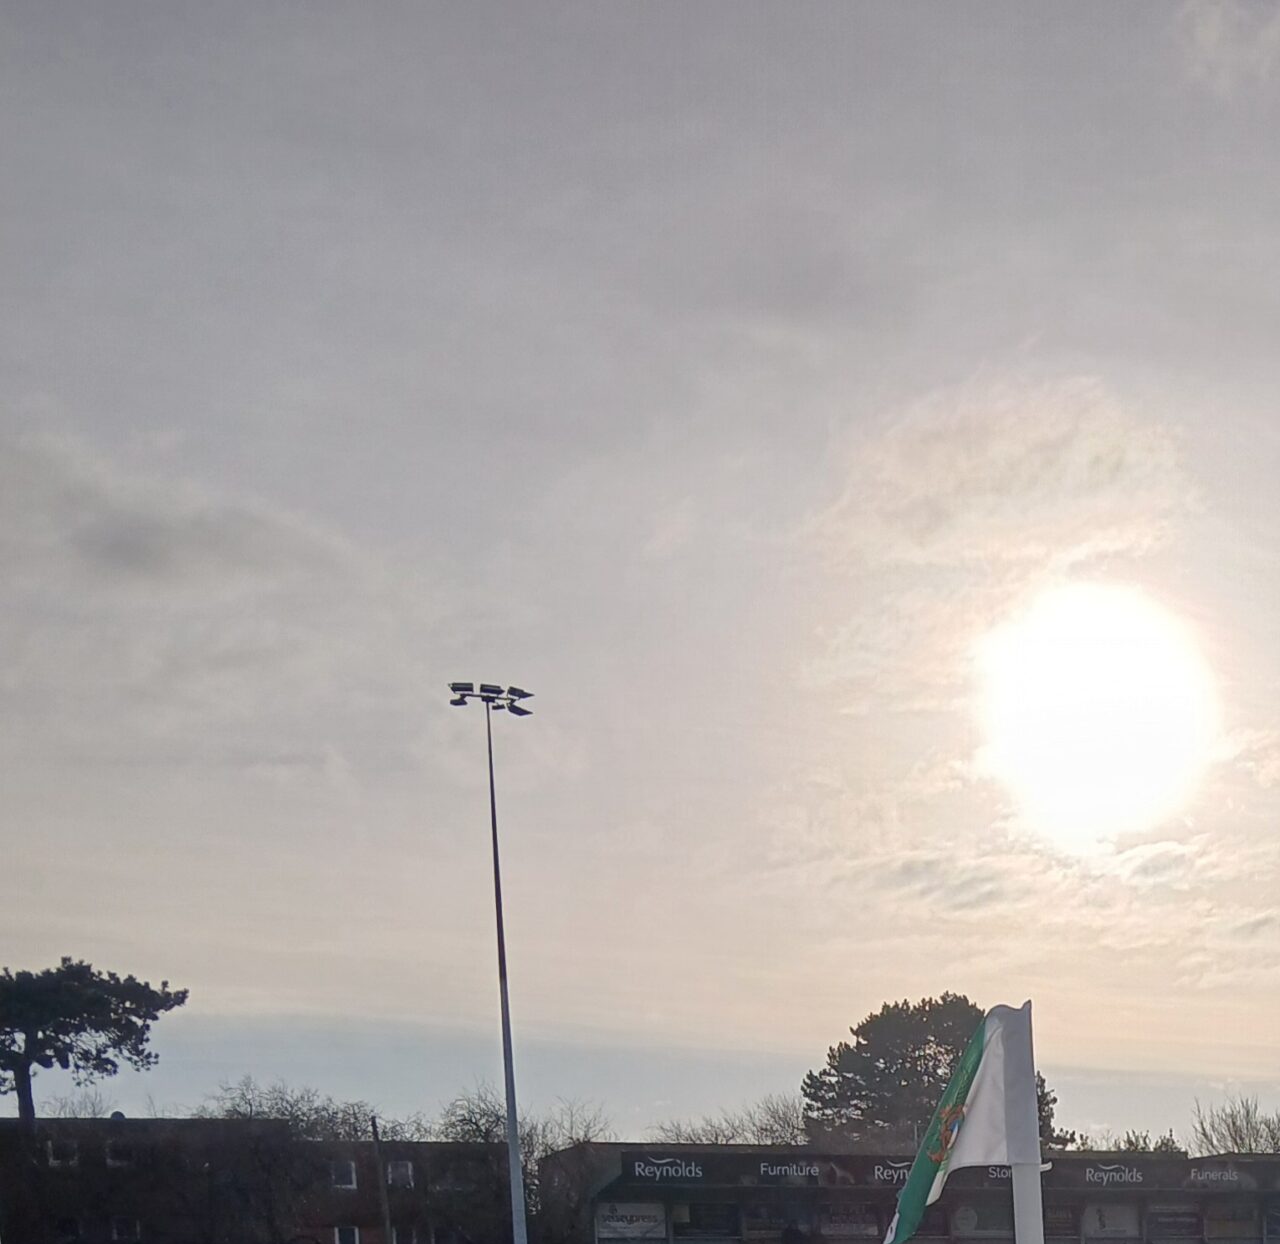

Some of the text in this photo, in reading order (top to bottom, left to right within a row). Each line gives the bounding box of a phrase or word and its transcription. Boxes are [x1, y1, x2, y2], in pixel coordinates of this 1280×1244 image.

[634, 1158, 703, 1181] Reynolds
[760, 1162, 820, 1176] Furniture
[1085, 1165, 1143, 1186] Reynolds
[1190, 1168, 1239, 1181] Funerals
